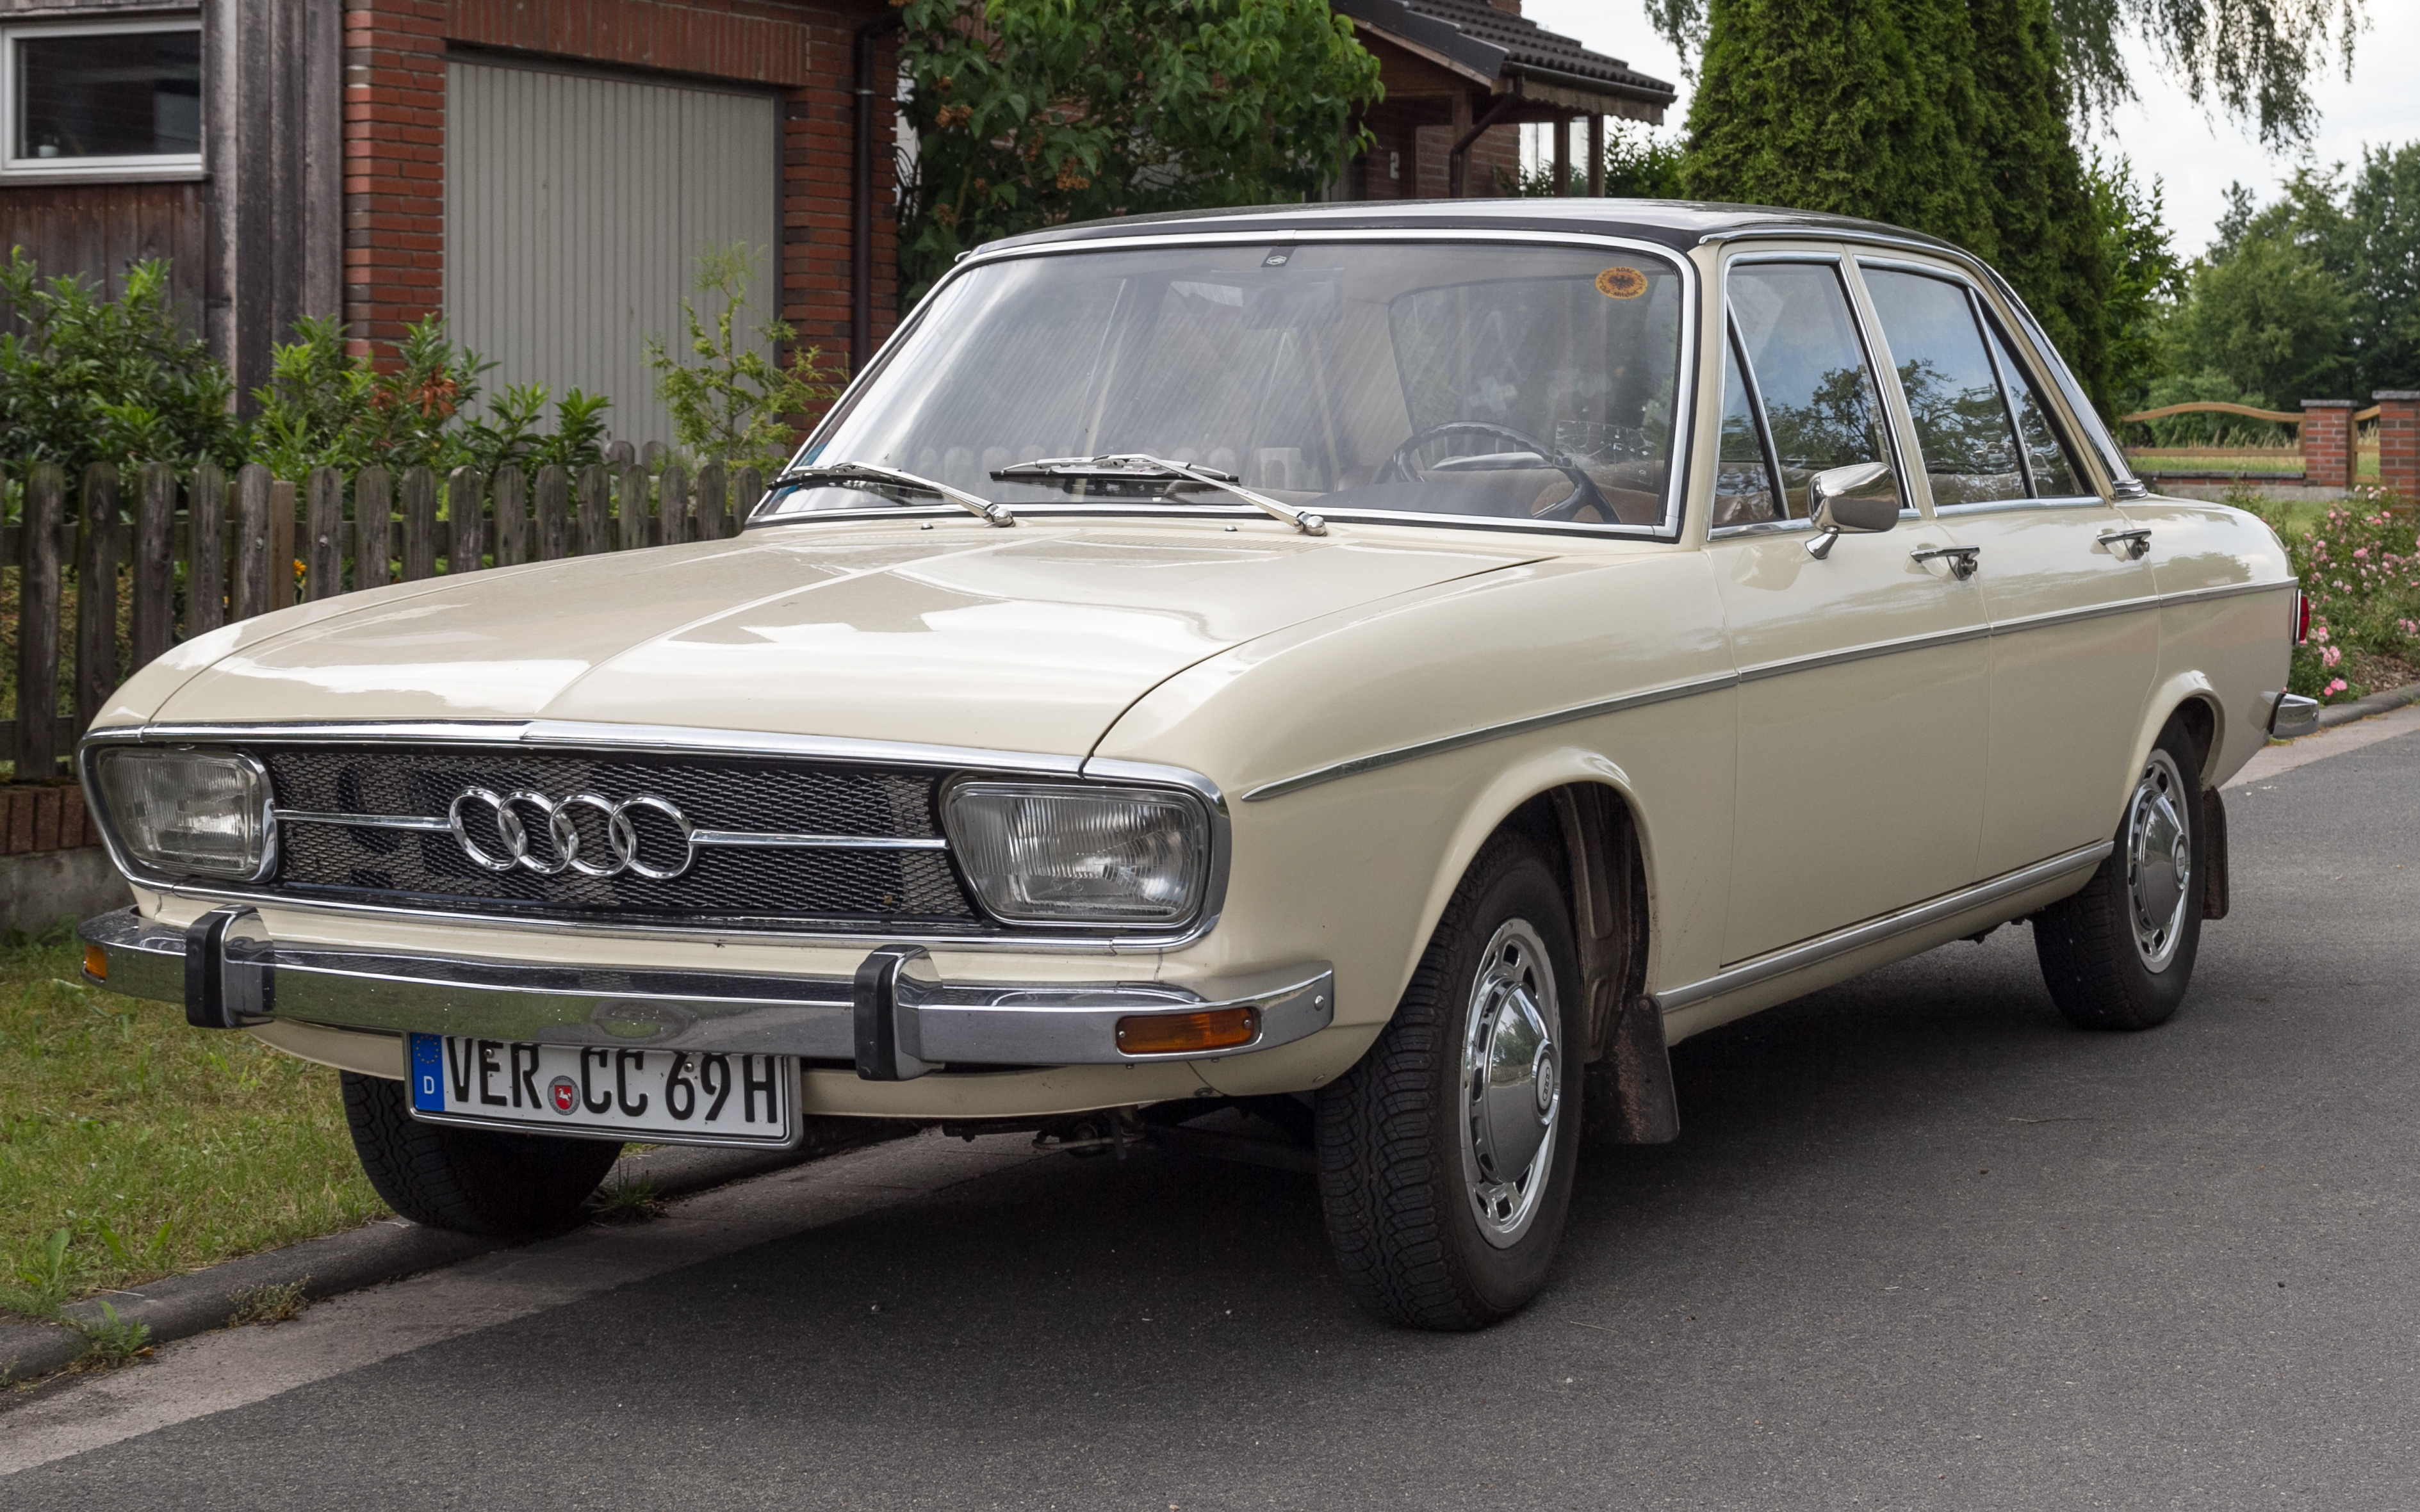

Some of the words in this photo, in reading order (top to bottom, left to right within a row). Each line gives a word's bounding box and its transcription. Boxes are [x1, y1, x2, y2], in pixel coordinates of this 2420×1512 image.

[423, 1075, 435, 1094] D
[446, 1036, 543, 1109] VER
[580, 1046, 648, 1117] CC
[665, 1051, 778, 1123] 69H
